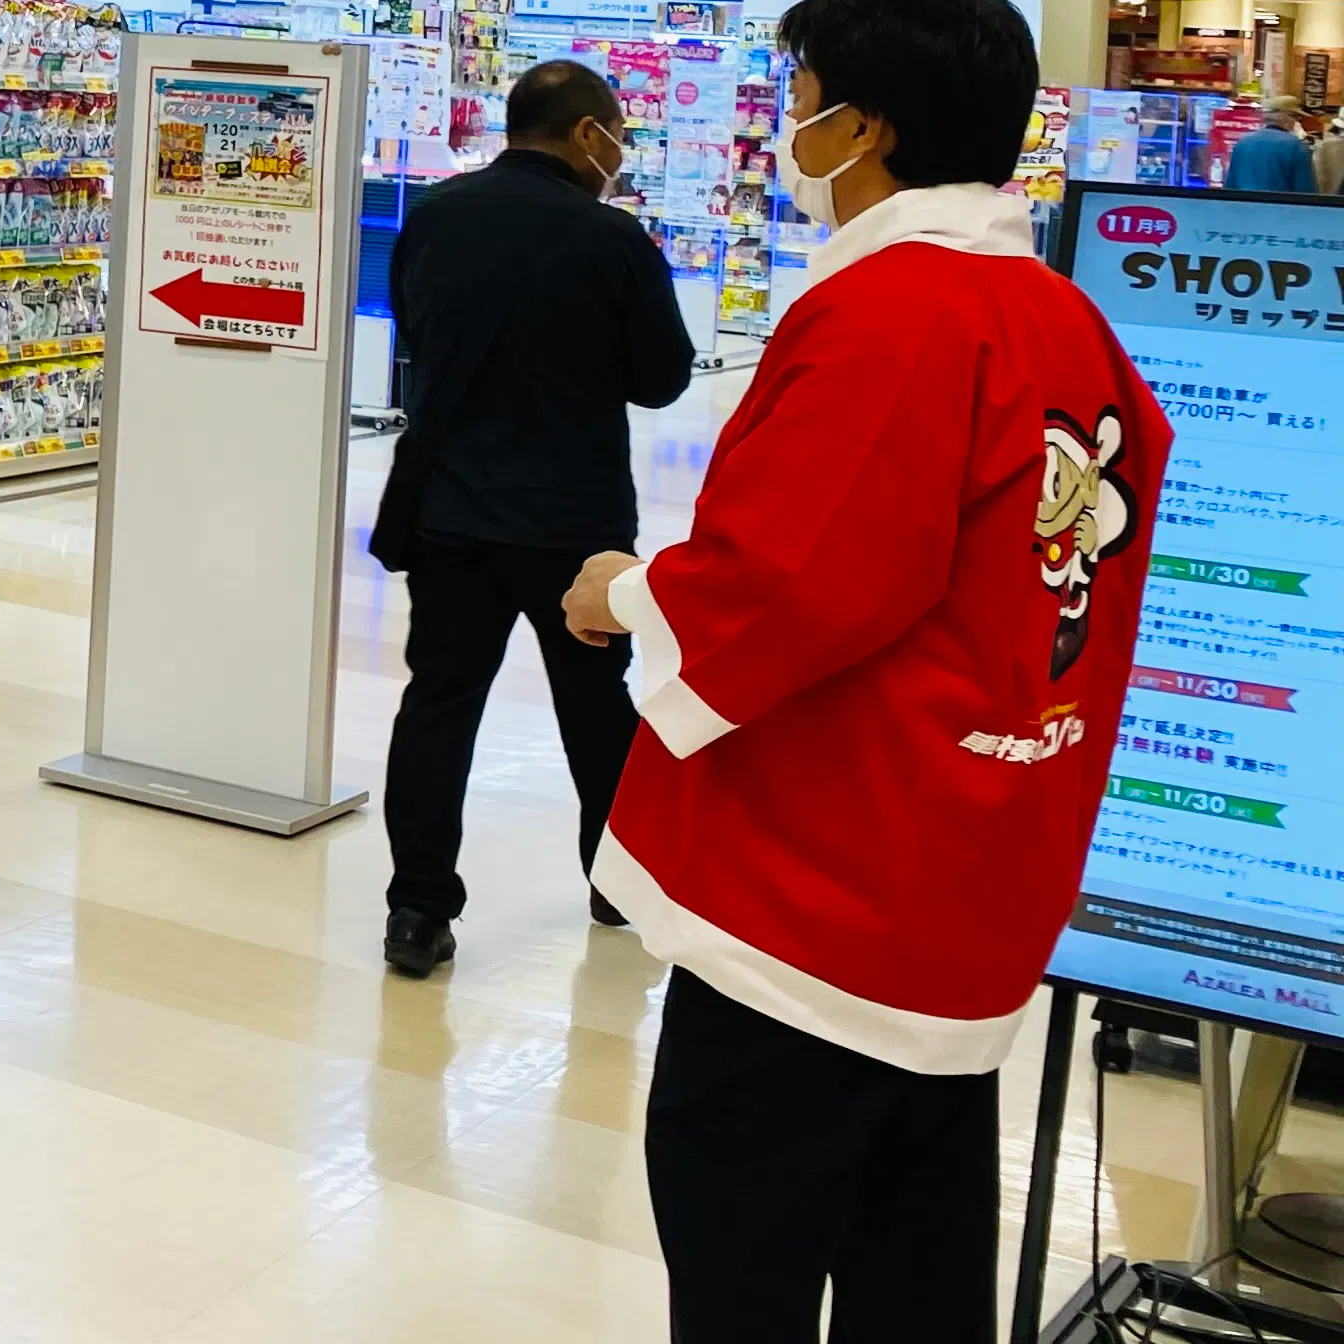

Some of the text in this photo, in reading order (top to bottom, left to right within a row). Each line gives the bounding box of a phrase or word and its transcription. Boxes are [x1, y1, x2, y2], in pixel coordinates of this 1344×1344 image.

[1106, 214, 1172, 235] 11月号
[1122, 252, 1311, 301] SHOP
[204, 318, 298, 340] 会場はこちらです
